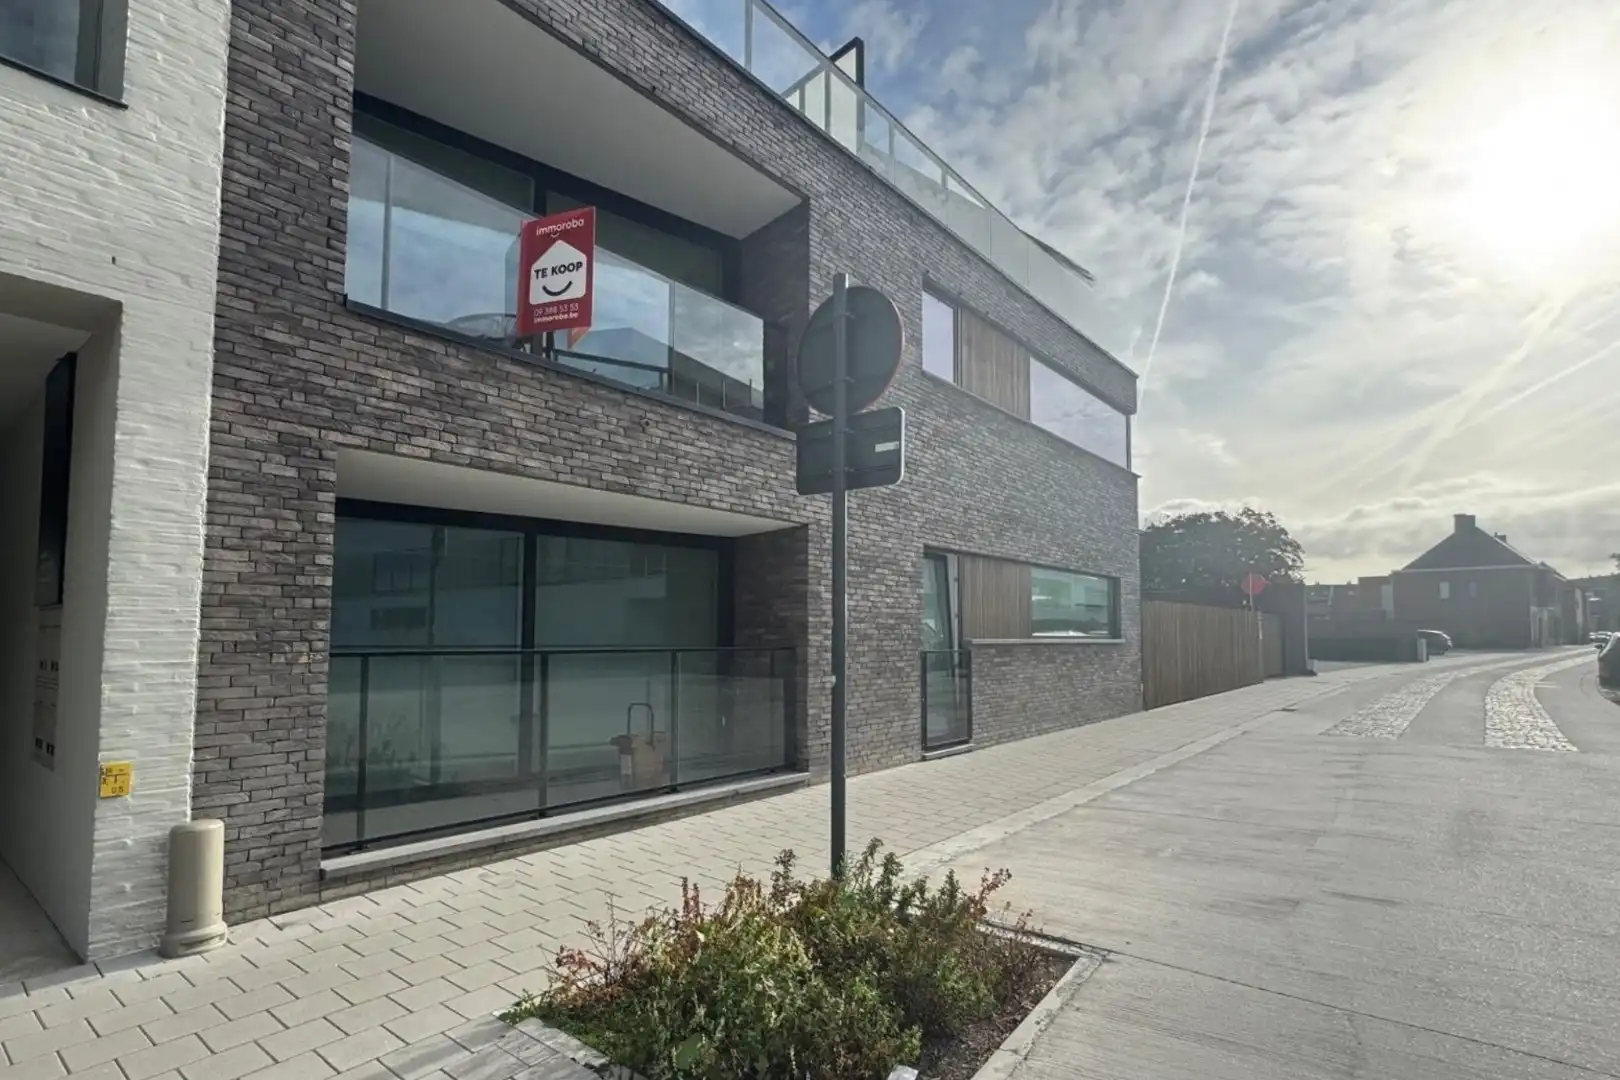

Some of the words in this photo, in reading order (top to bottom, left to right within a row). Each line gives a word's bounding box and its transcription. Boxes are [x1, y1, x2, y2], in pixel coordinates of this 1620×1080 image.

[536, 218, 584, 236] immoroba
[534, 267, 548, 280] TE
[551, 261, 583, 276] KOOP
